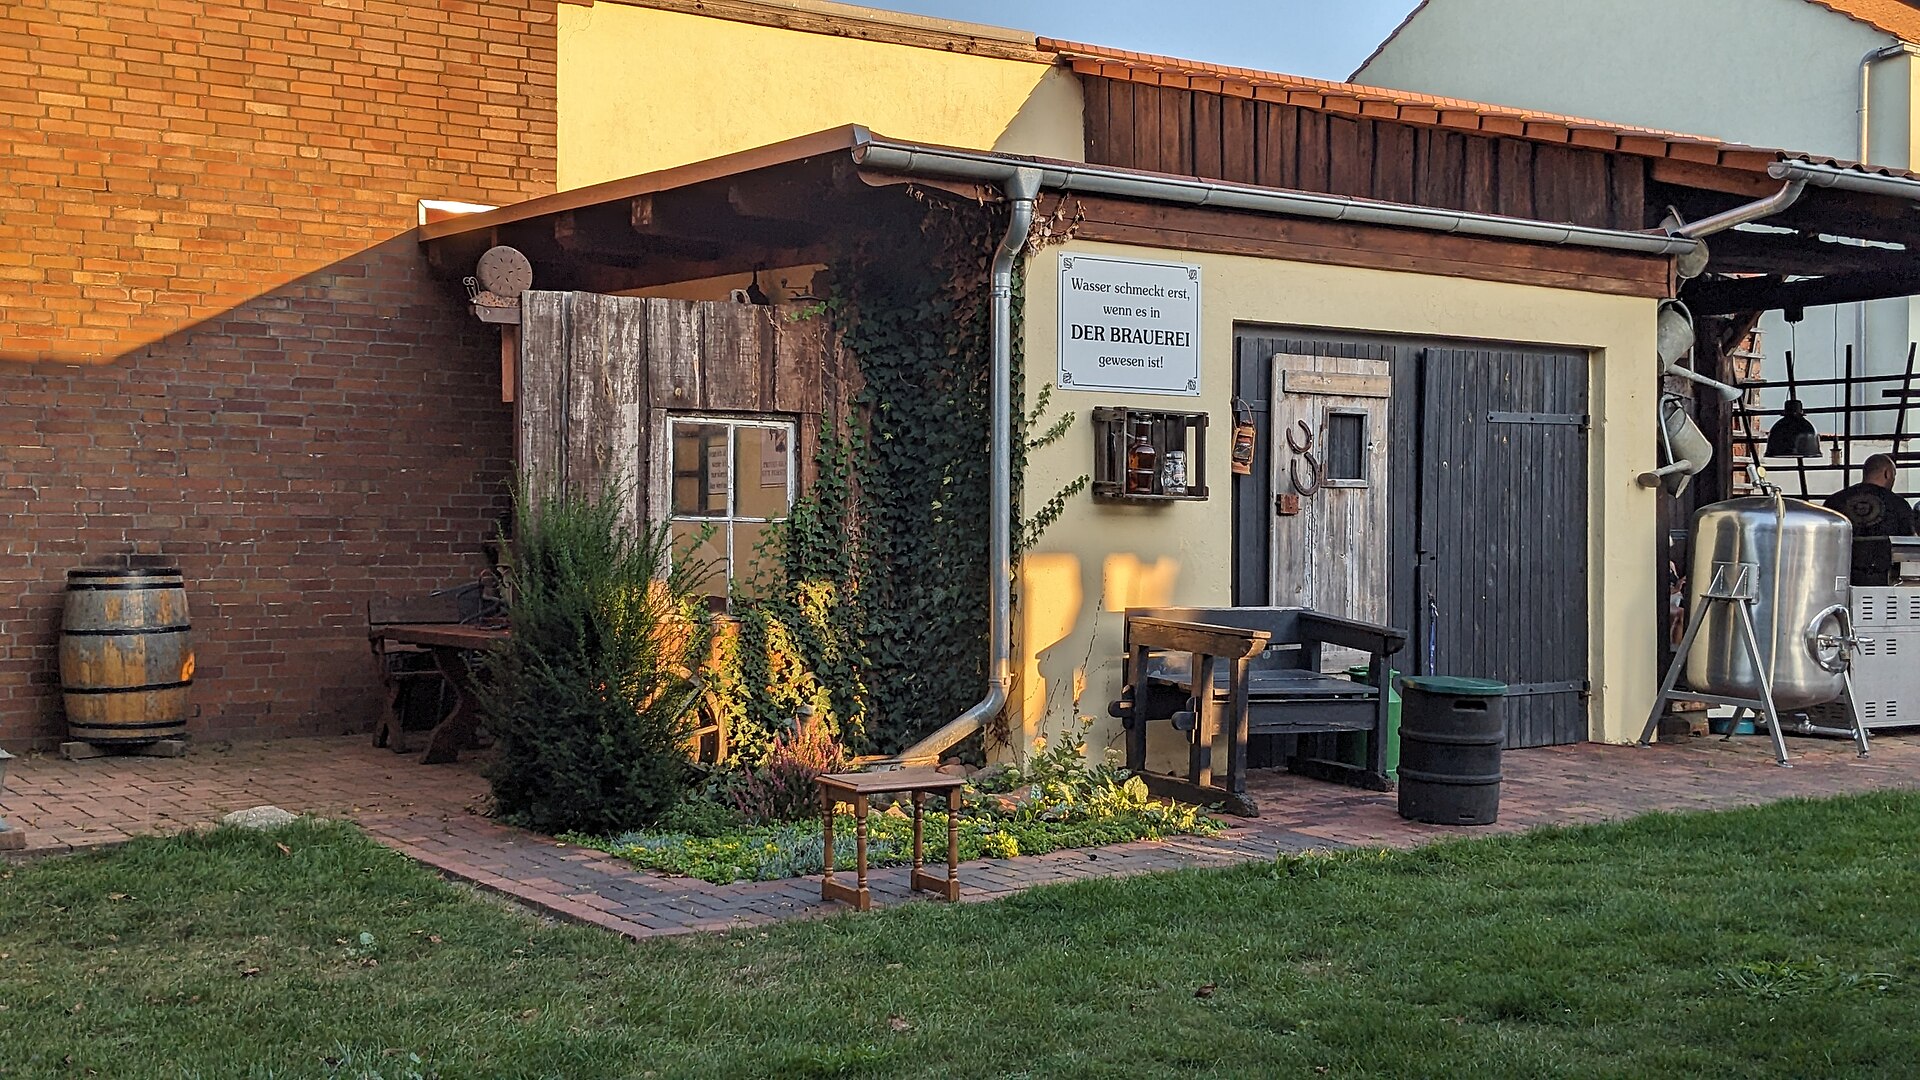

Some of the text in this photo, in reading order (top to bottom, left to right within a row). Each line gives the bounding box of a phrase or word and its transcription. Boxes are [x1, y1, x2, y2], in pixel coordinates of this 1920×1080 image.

[1071, 277, 1190, 301] Wasser schmeckt erst,
[1103, 305, 1160, 318] wenn es in
[1071, 324, 1190, 347] DER BRAUEREI
[1098, 356, 1163, 368] gewesen ist!
